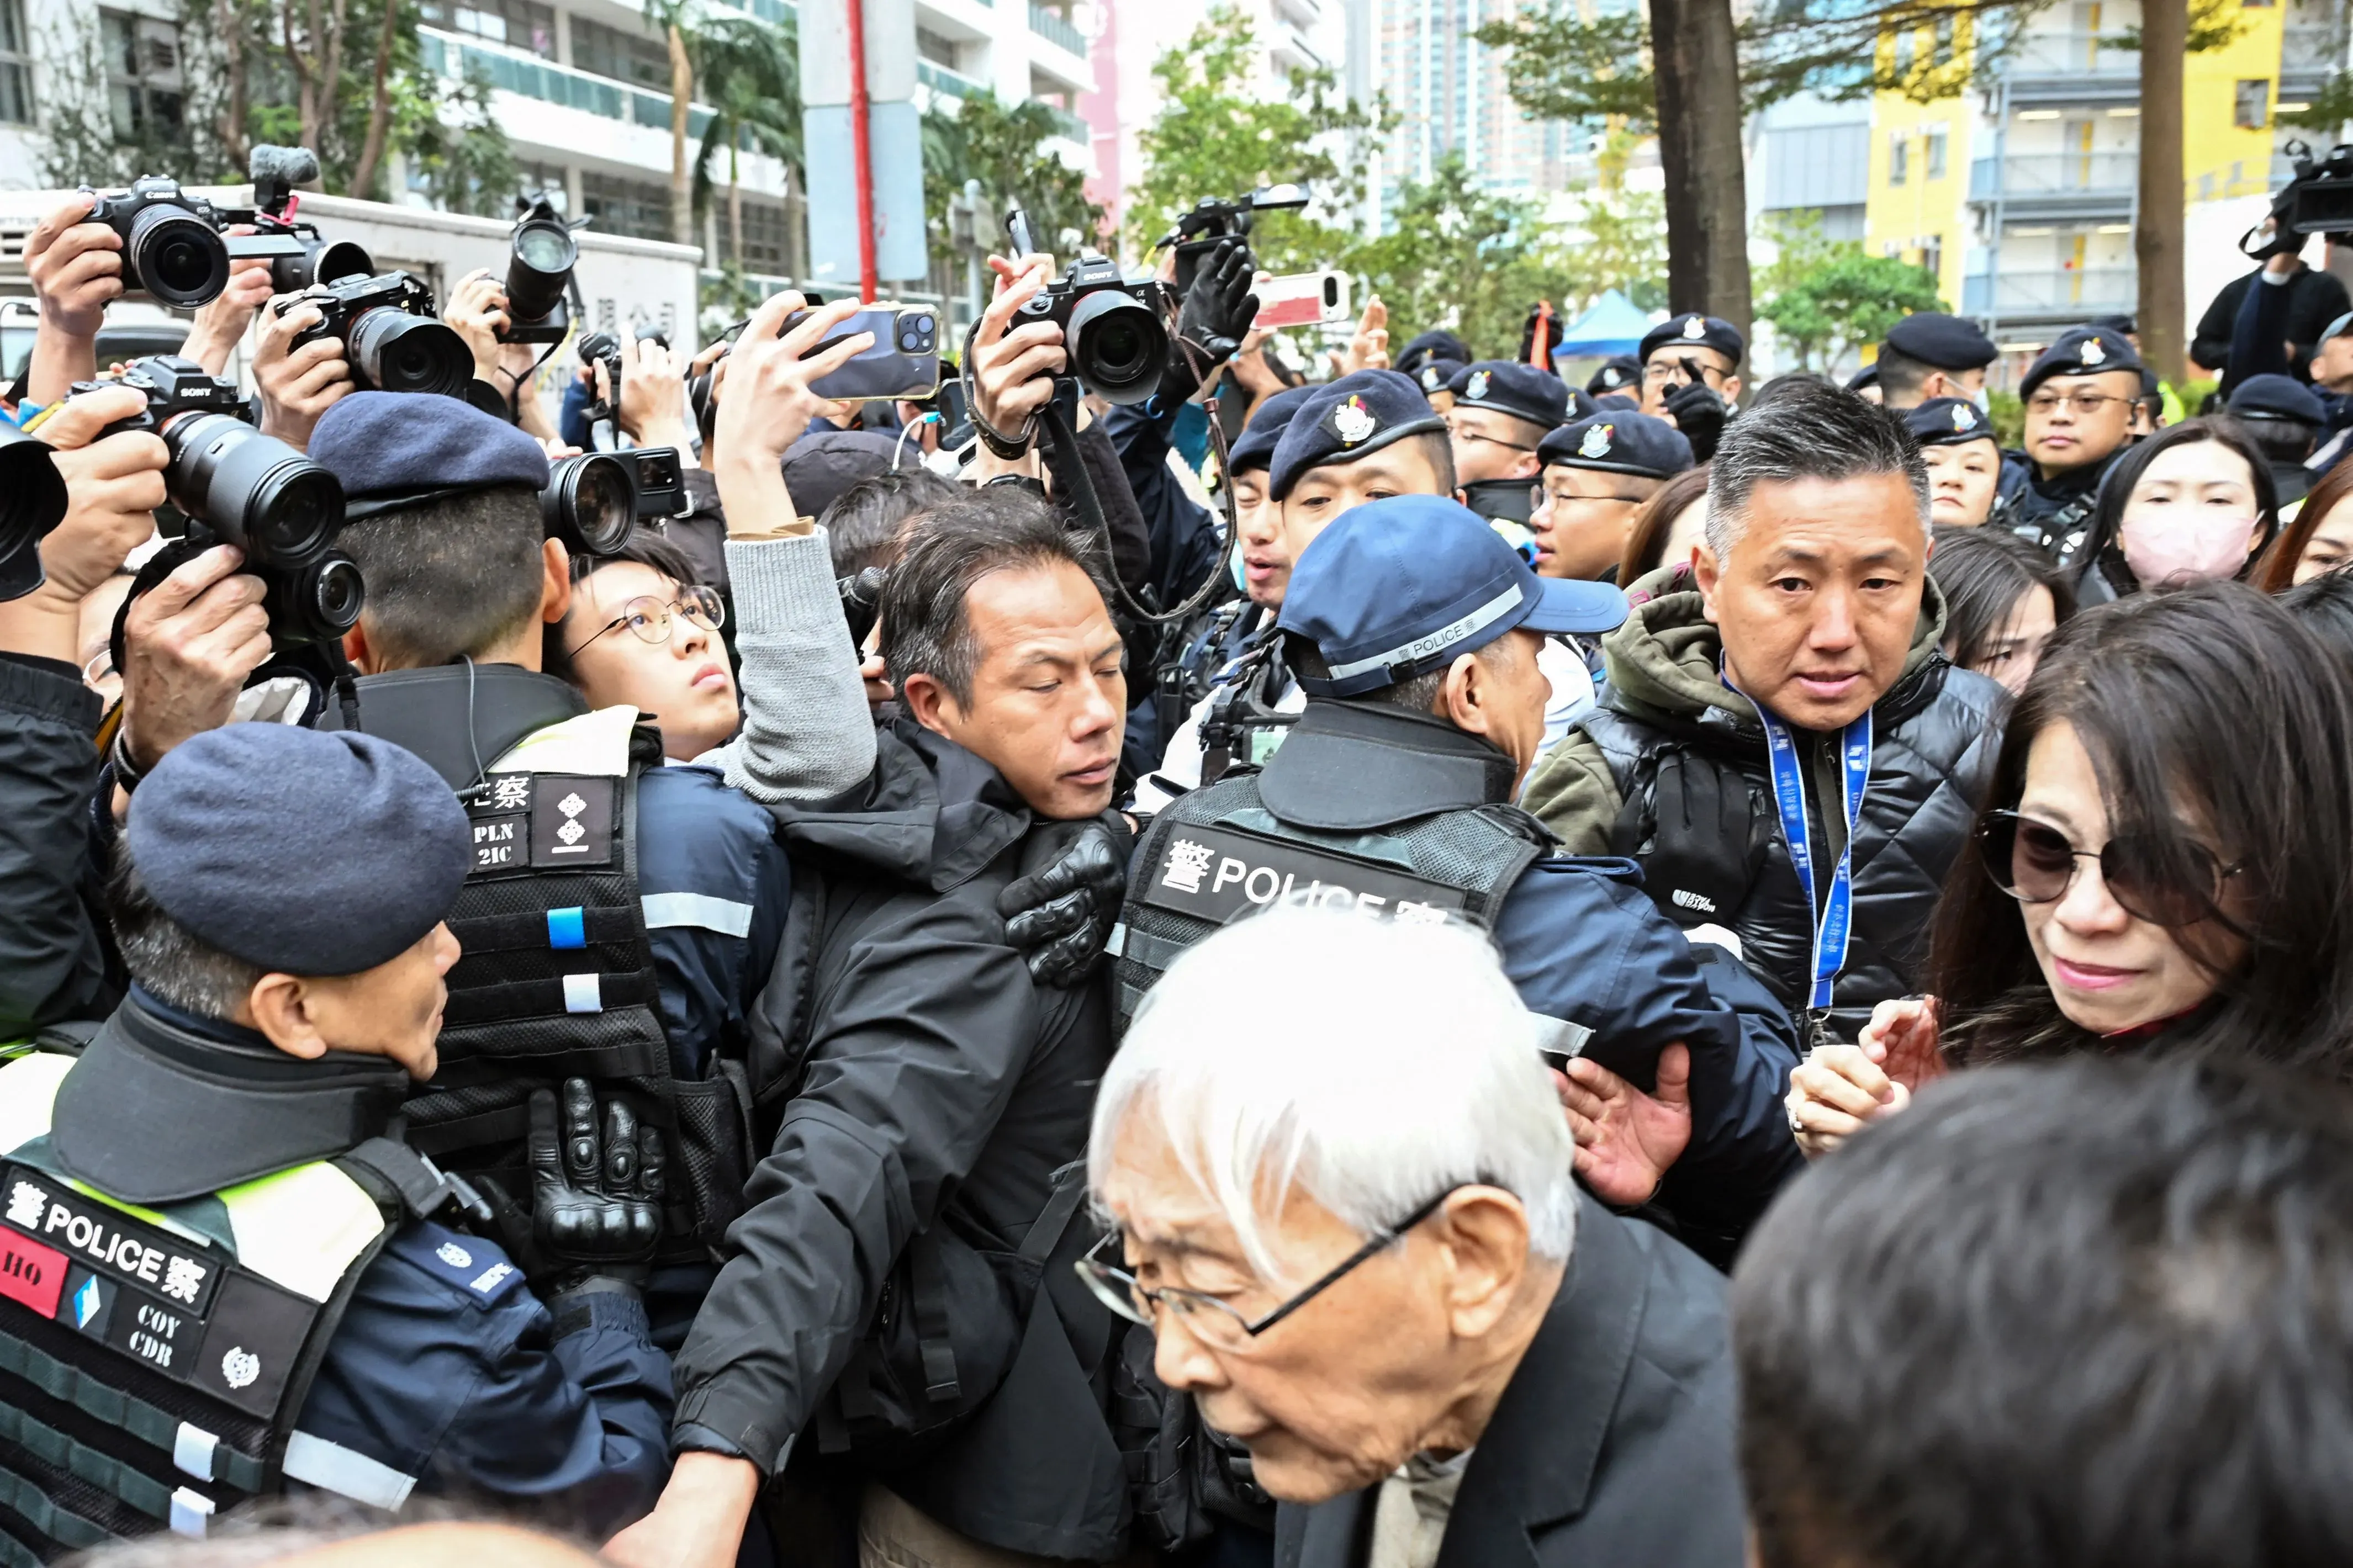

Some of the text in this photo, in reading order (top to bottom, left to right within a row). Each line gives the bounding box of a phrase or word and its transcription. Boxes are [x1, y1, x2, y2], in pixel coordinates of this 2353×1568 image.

[196, 205, 210, 214] EOS
[1083, 271, 1113, 280] SONY
[180, 388, 211, 397] SONY
[1413, 625, 1463, 655] POLICE
[473, 823, 514, 844] PLN
[478, 845, 511, 865] 2IC
[1161, 839, 1215, 894] 警
[45, 1204, 166, 1283] POLICE
[161, 1256, 207, 1304] 察
[138, 1304, 181, 1339] COY
[129, 1331, 173, 1368] CDR
